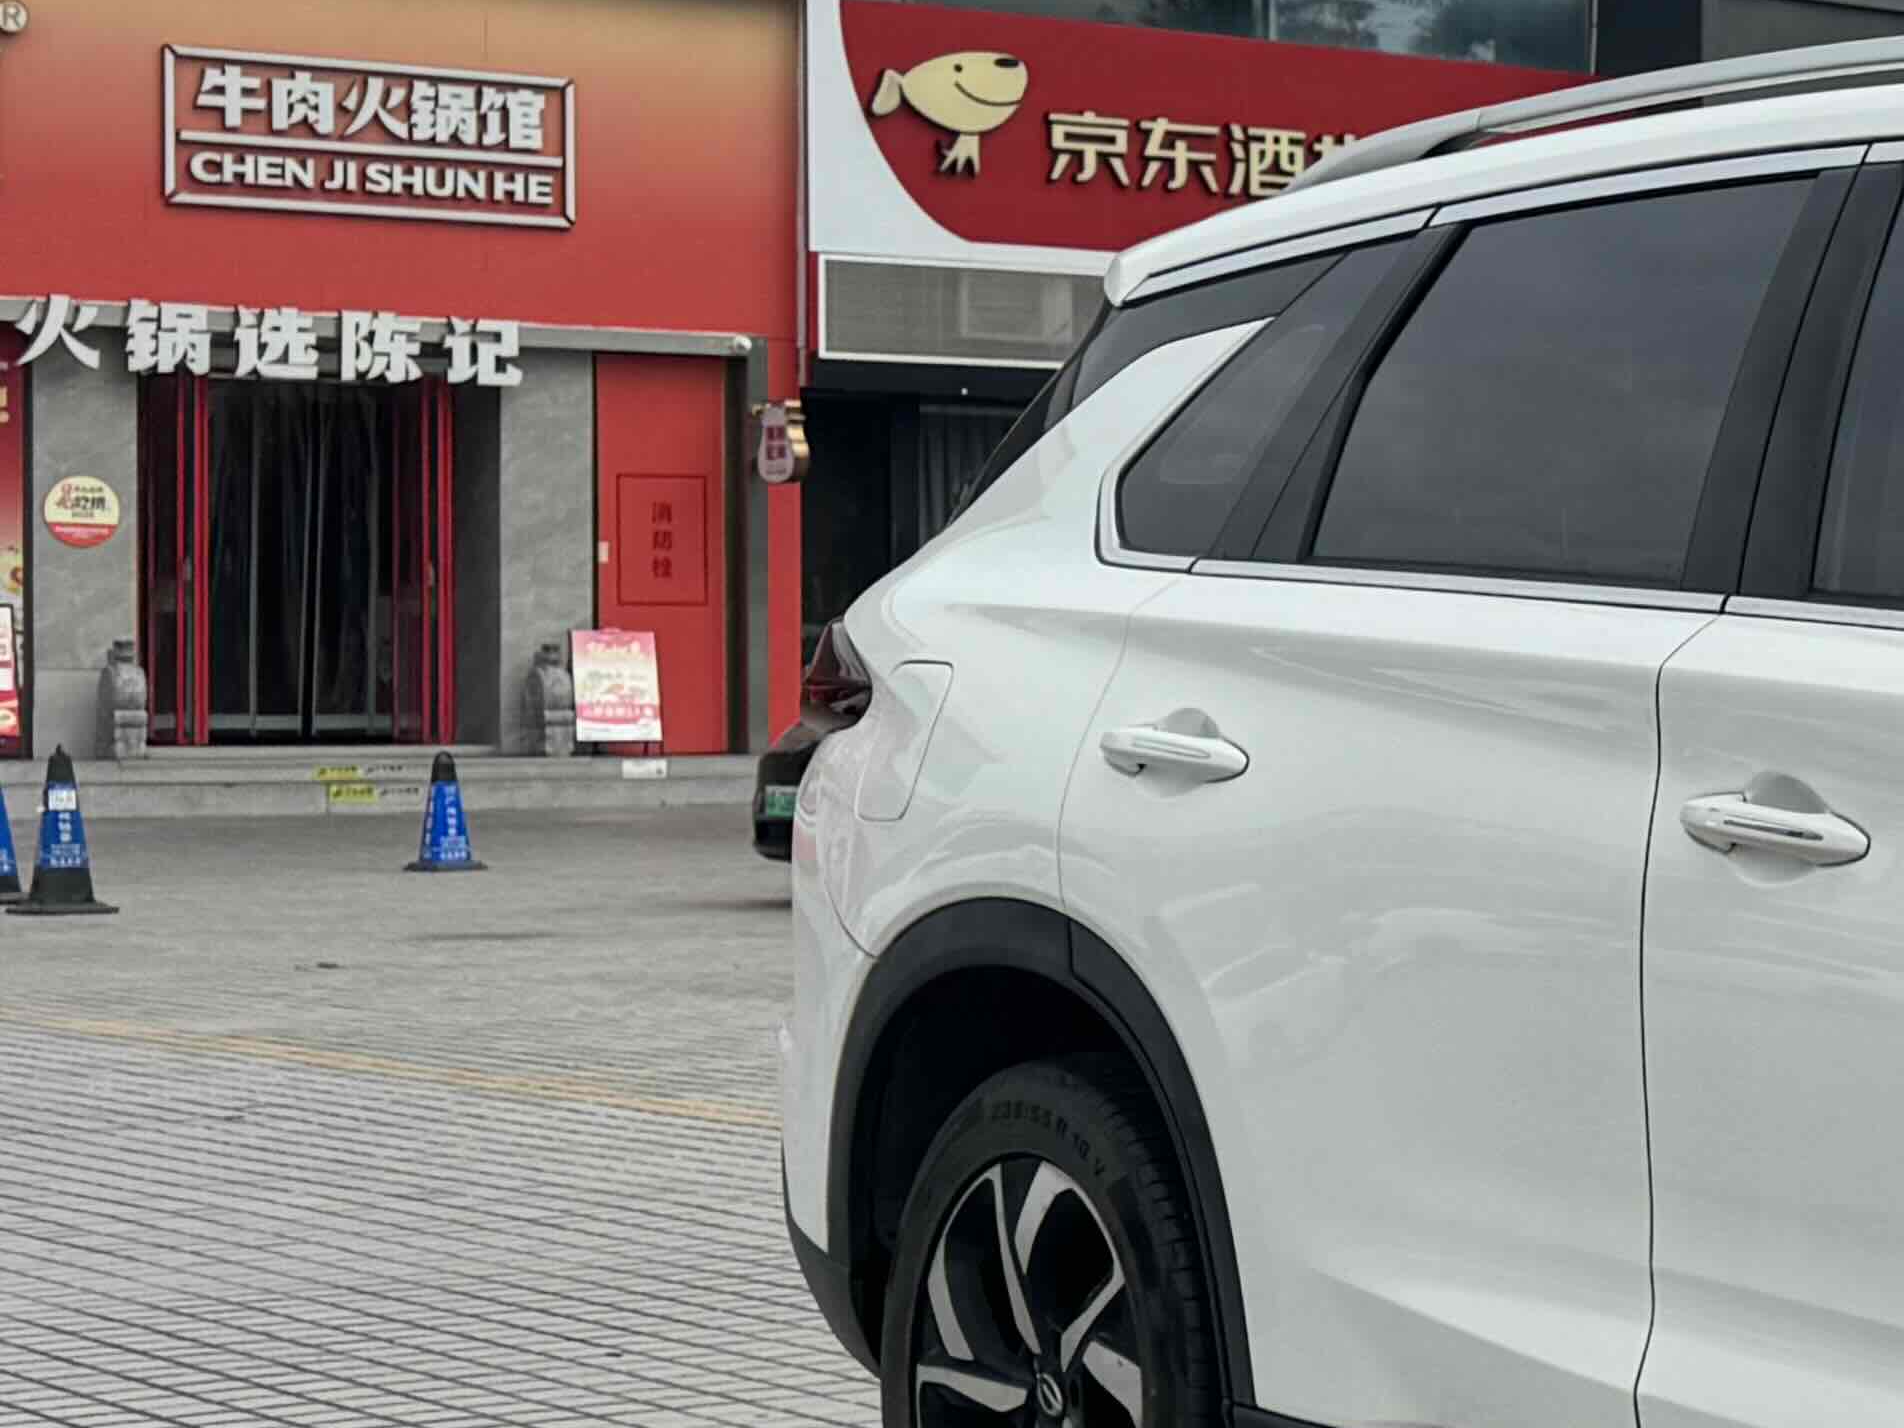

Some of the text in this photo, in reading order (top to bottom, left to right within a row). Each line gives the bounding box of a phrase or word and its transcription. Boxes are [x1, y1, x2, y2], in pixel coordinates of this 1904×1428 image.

[197, 65, 546, 151] 牛肉火锅馆
[190, 151, 553, 205] CHEN JI SHUN HE
[15, 294, 524, 386] 火锅选陈记
